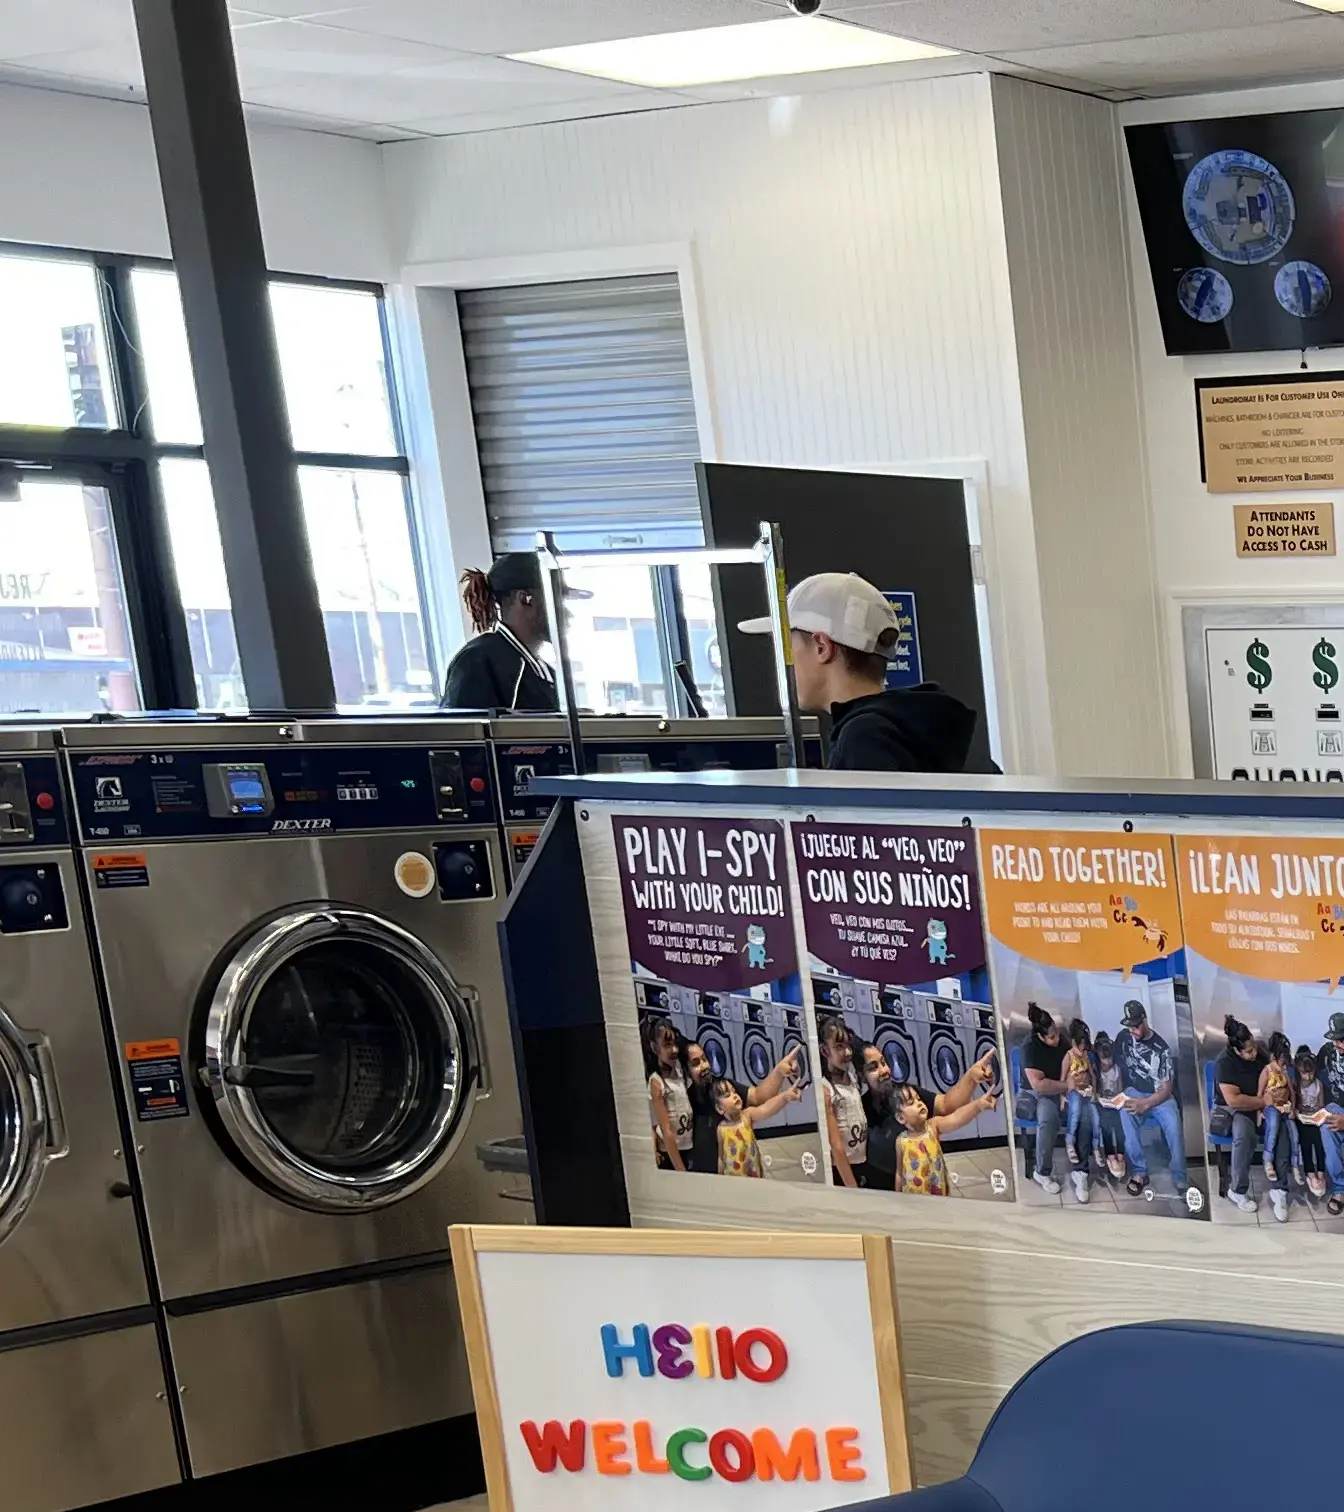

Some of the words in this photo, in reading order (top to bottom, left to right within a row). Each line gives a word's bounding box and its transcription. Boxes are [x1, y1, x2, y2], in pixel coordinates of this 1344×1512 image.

[1248, 526, 1263, 537] DO
[1267, 525, 1289, 536] NOT
[1292, 525, 1320, 536] HAVE
[1251, 511, 1315, 522] ATTENDANTS
[1242, 540, 1278, 551] ACCESS
[1281, 540, 1296, 550] TO
[1300, 540, 1328, 551] CASH
[271, 819, 331, 831] DEXTER
[623, 826, 686, 876] PLAY
[698, 828, 776, 881] I-SPY
[801, 832, 857, 860] ¡JUEGUE
[861, 839, 879, 860] AL
[991, 845, 1044, 882] READ
[1049, 848, 1167, 888] TOGETHER!
[1188, 850, 1260, 895] ¡LEAN
[631, 880, 676, 909] WITH
[680, 884, 724, 914] YOUR
[728, 885, 785, 918] CHILD!
[807, 869, 849, 902] CON
[854, 872, 893, 904] SUS
[899, 868, 971, 911] NIÑOS!
[519, 1419, 866, 1484] WELCOME
